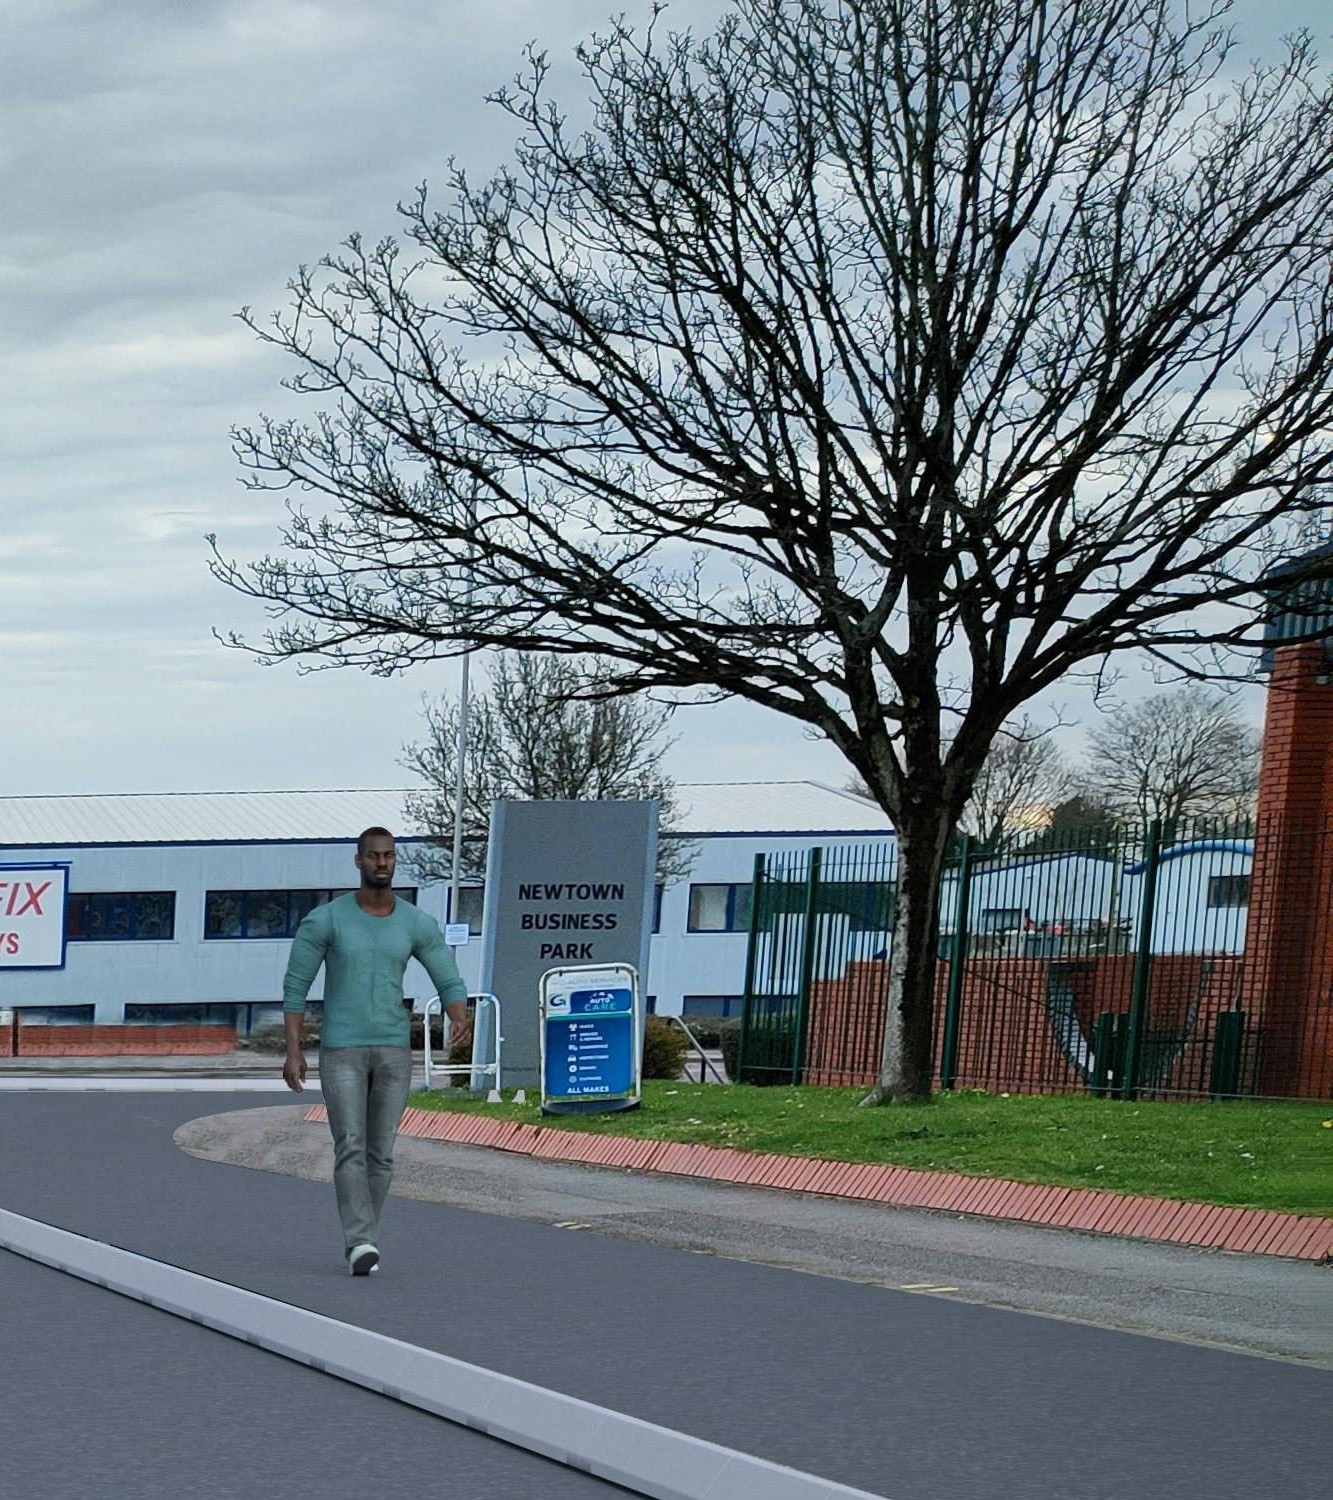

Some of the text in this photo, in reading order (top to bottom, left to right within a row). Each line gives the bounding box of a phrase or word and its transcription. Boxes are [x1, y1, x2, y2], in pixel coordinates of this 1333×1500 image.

[518, 884, 624, 900] NEWTOWN
[521, 913, 617, 930] BUSINESS
[540, 943, 594, 959] PARK
[584, 1003, 616, 1011] CARE
[583, 1085, 610, 1093] MAKES
